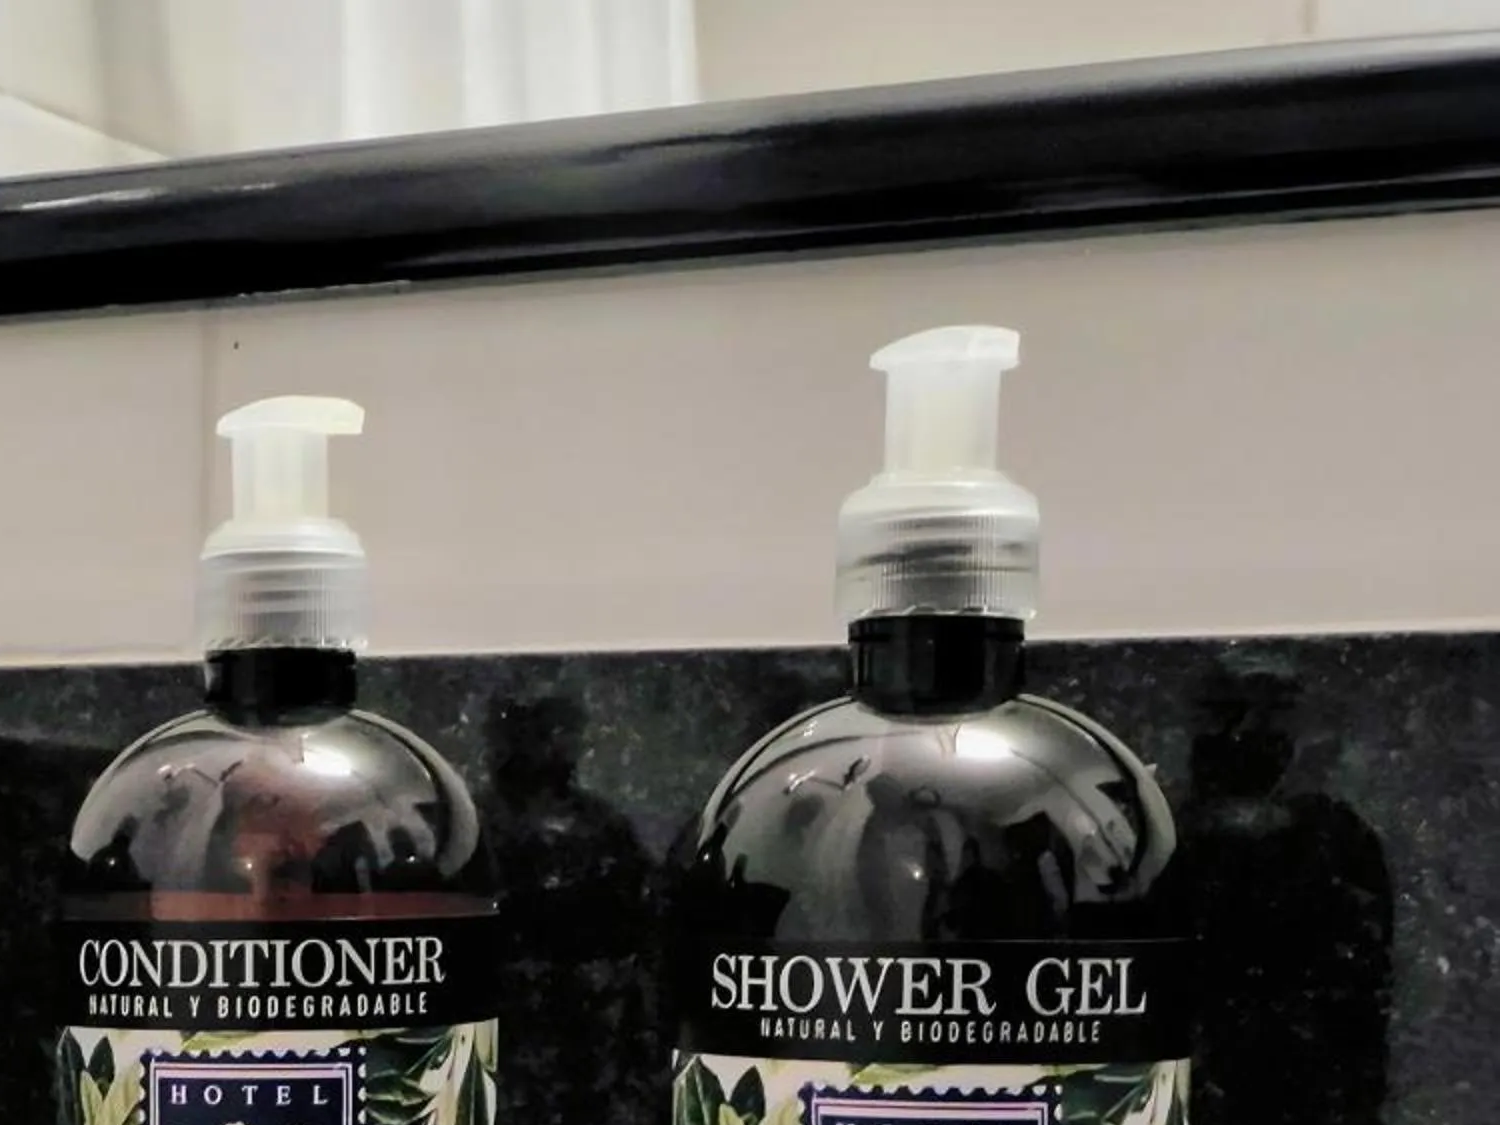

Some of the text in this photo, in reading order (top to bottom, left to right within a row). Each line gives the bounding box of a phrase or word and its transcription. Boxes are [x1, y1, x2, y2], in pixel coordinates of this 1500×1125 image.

[79, 936, 447, 988] CONDITIONER
[711, 953, 1146, 1016] SHOWER GEL
[89, 992, 428, 1019] NATURAL Y BIODEGRADABLE
[761, 1016, 1101, 1044] NATURAL Y BIODEGRADABLE
[171, 1084, 329, 1106] HOTEL
